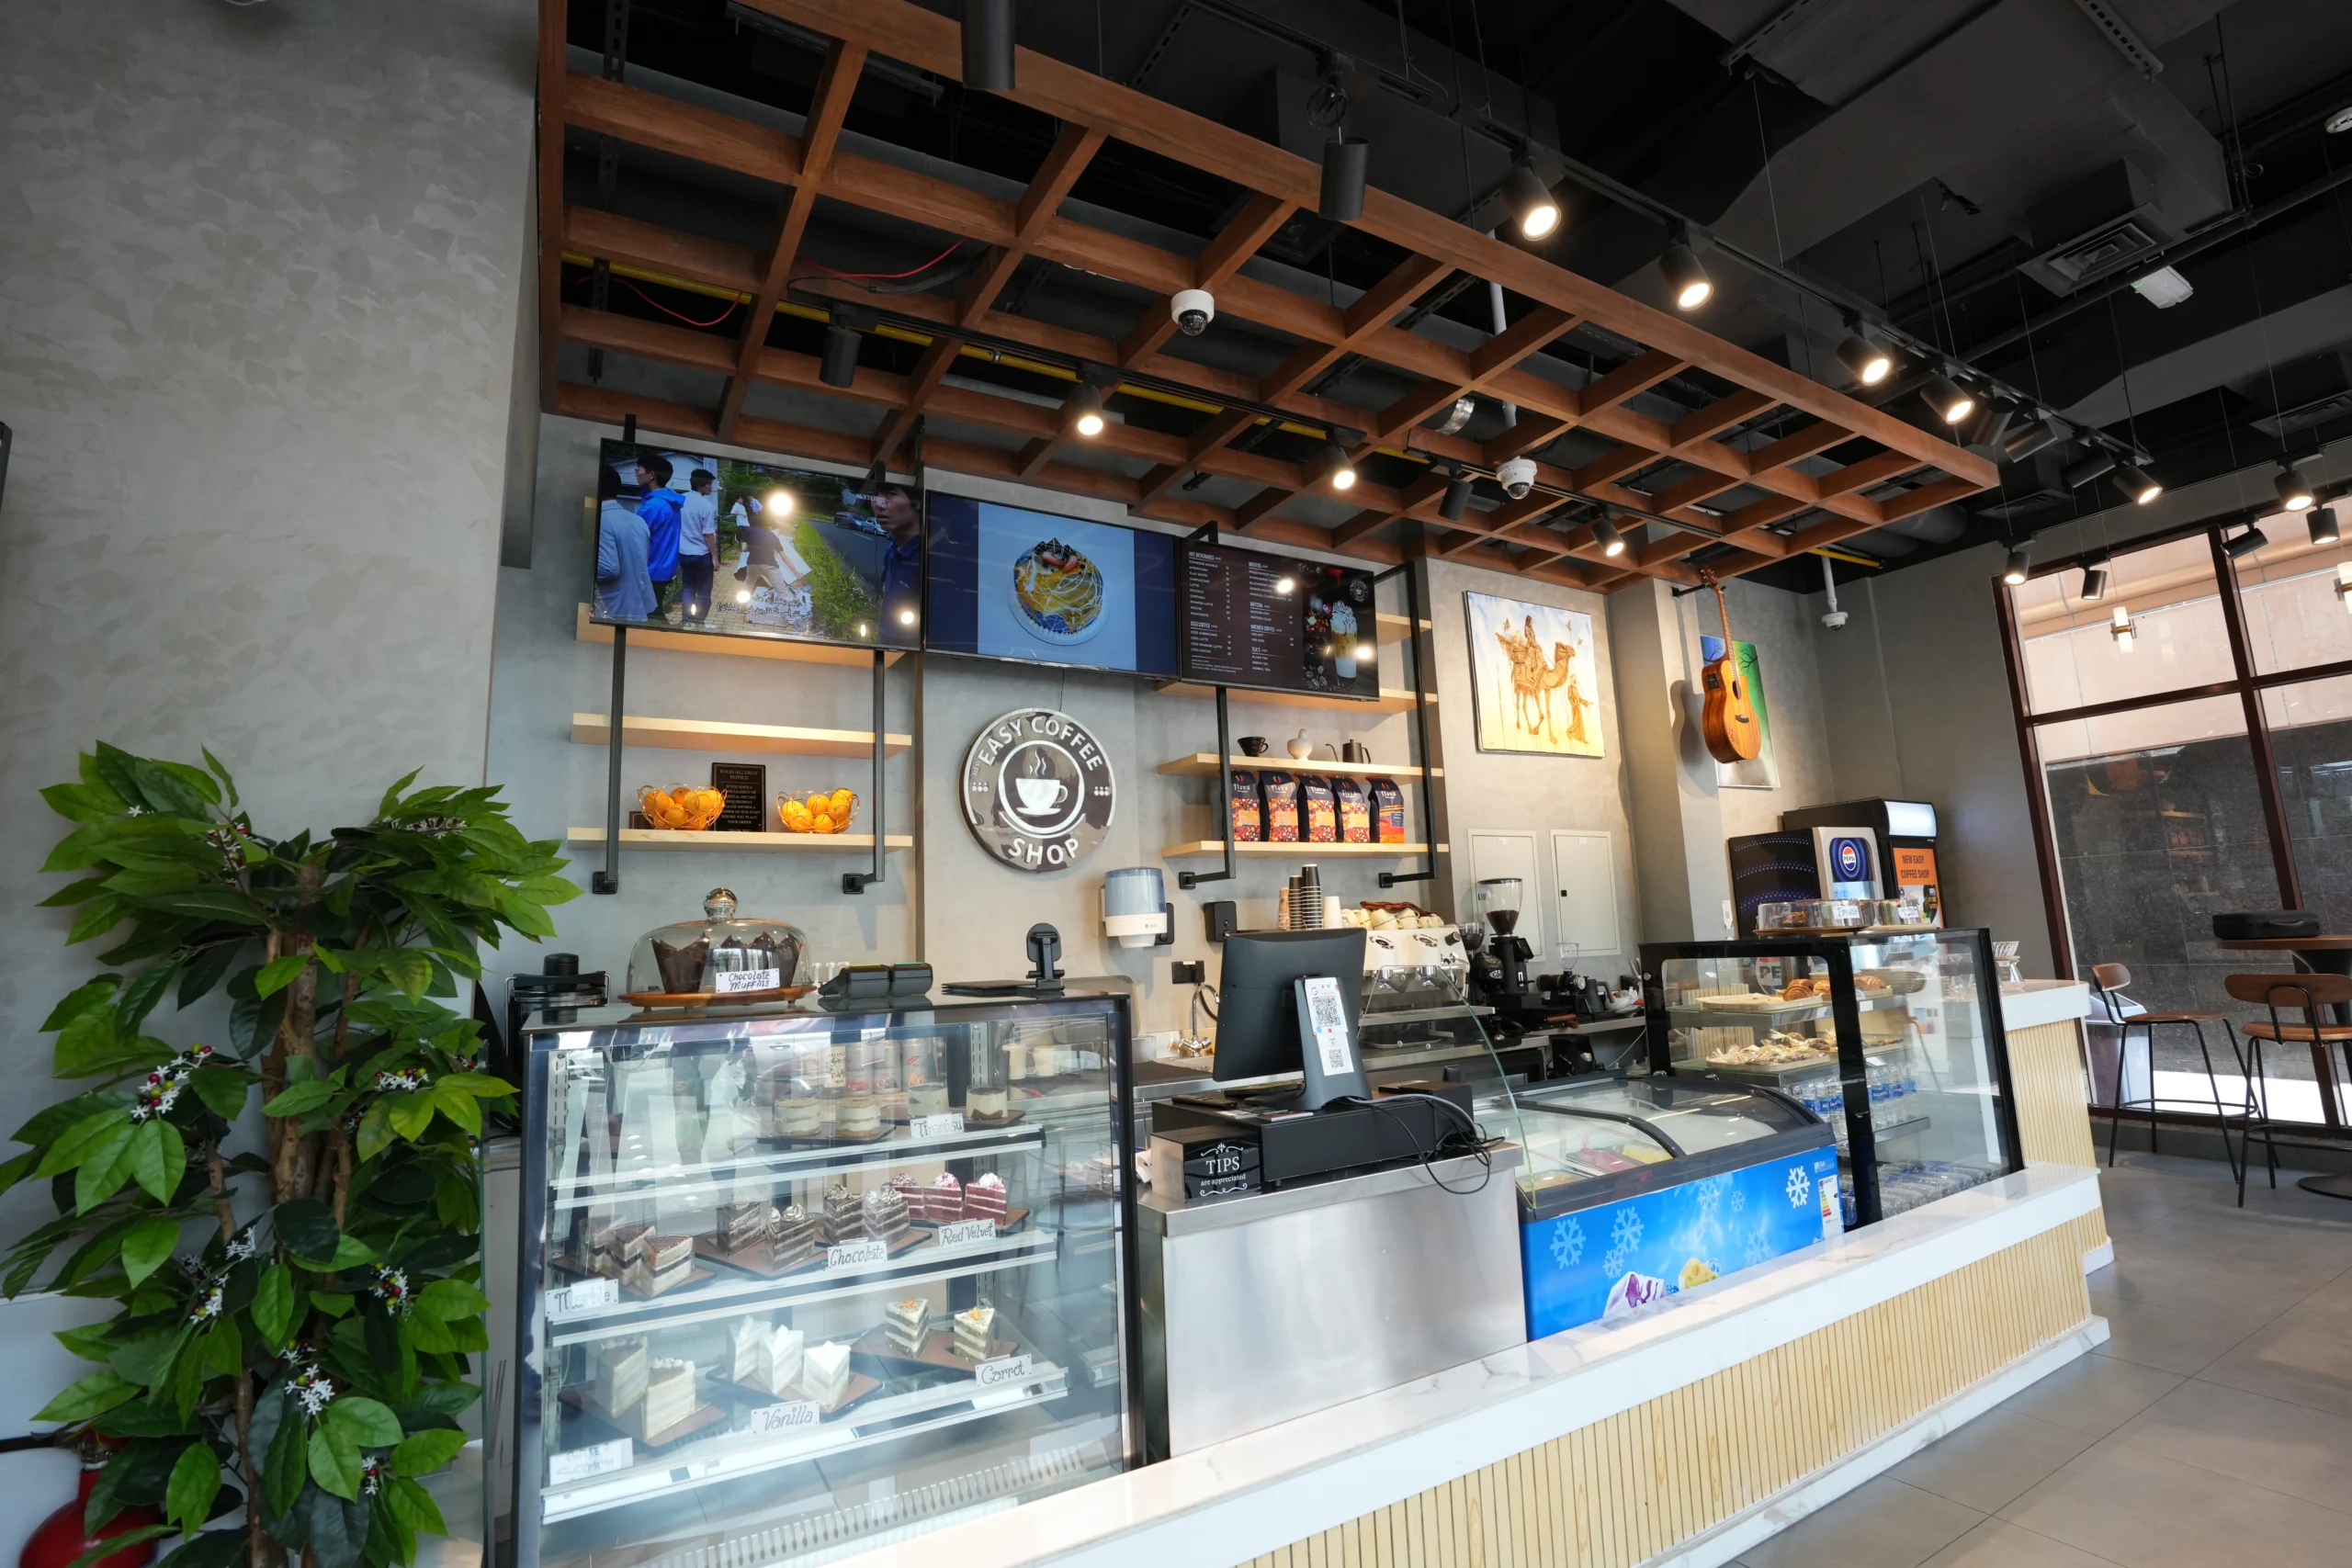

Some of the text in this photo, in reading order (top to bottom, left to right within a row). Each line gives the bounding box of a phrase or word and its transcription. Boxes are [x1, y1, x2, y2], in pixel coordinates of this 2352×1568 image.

[978, 716, 1103, 772] EASY COFFEE
[972, 760, 980, 776] NEW
[1008, 838, 1080, 865] SHOP
[1902, 855, 1924, 864] NEW EASY
[1901, 869, 1929, 879] COFFEE SHOP
[729, 969, 770, 982] Chocolate
[914, 1120, 963, 1138] Tiramisu
[1205, 1156, 1240, 1175] TIPS
[1211, 1173, 1246, 1187] appreciated
[942, 1222, 994, 1247] Red Velvet
[831, 1246, 885, 1267] Chocolate
[981, 1360, 1025, 1384] Carrot
[763, 1408, 814, 1430] Vanilla
